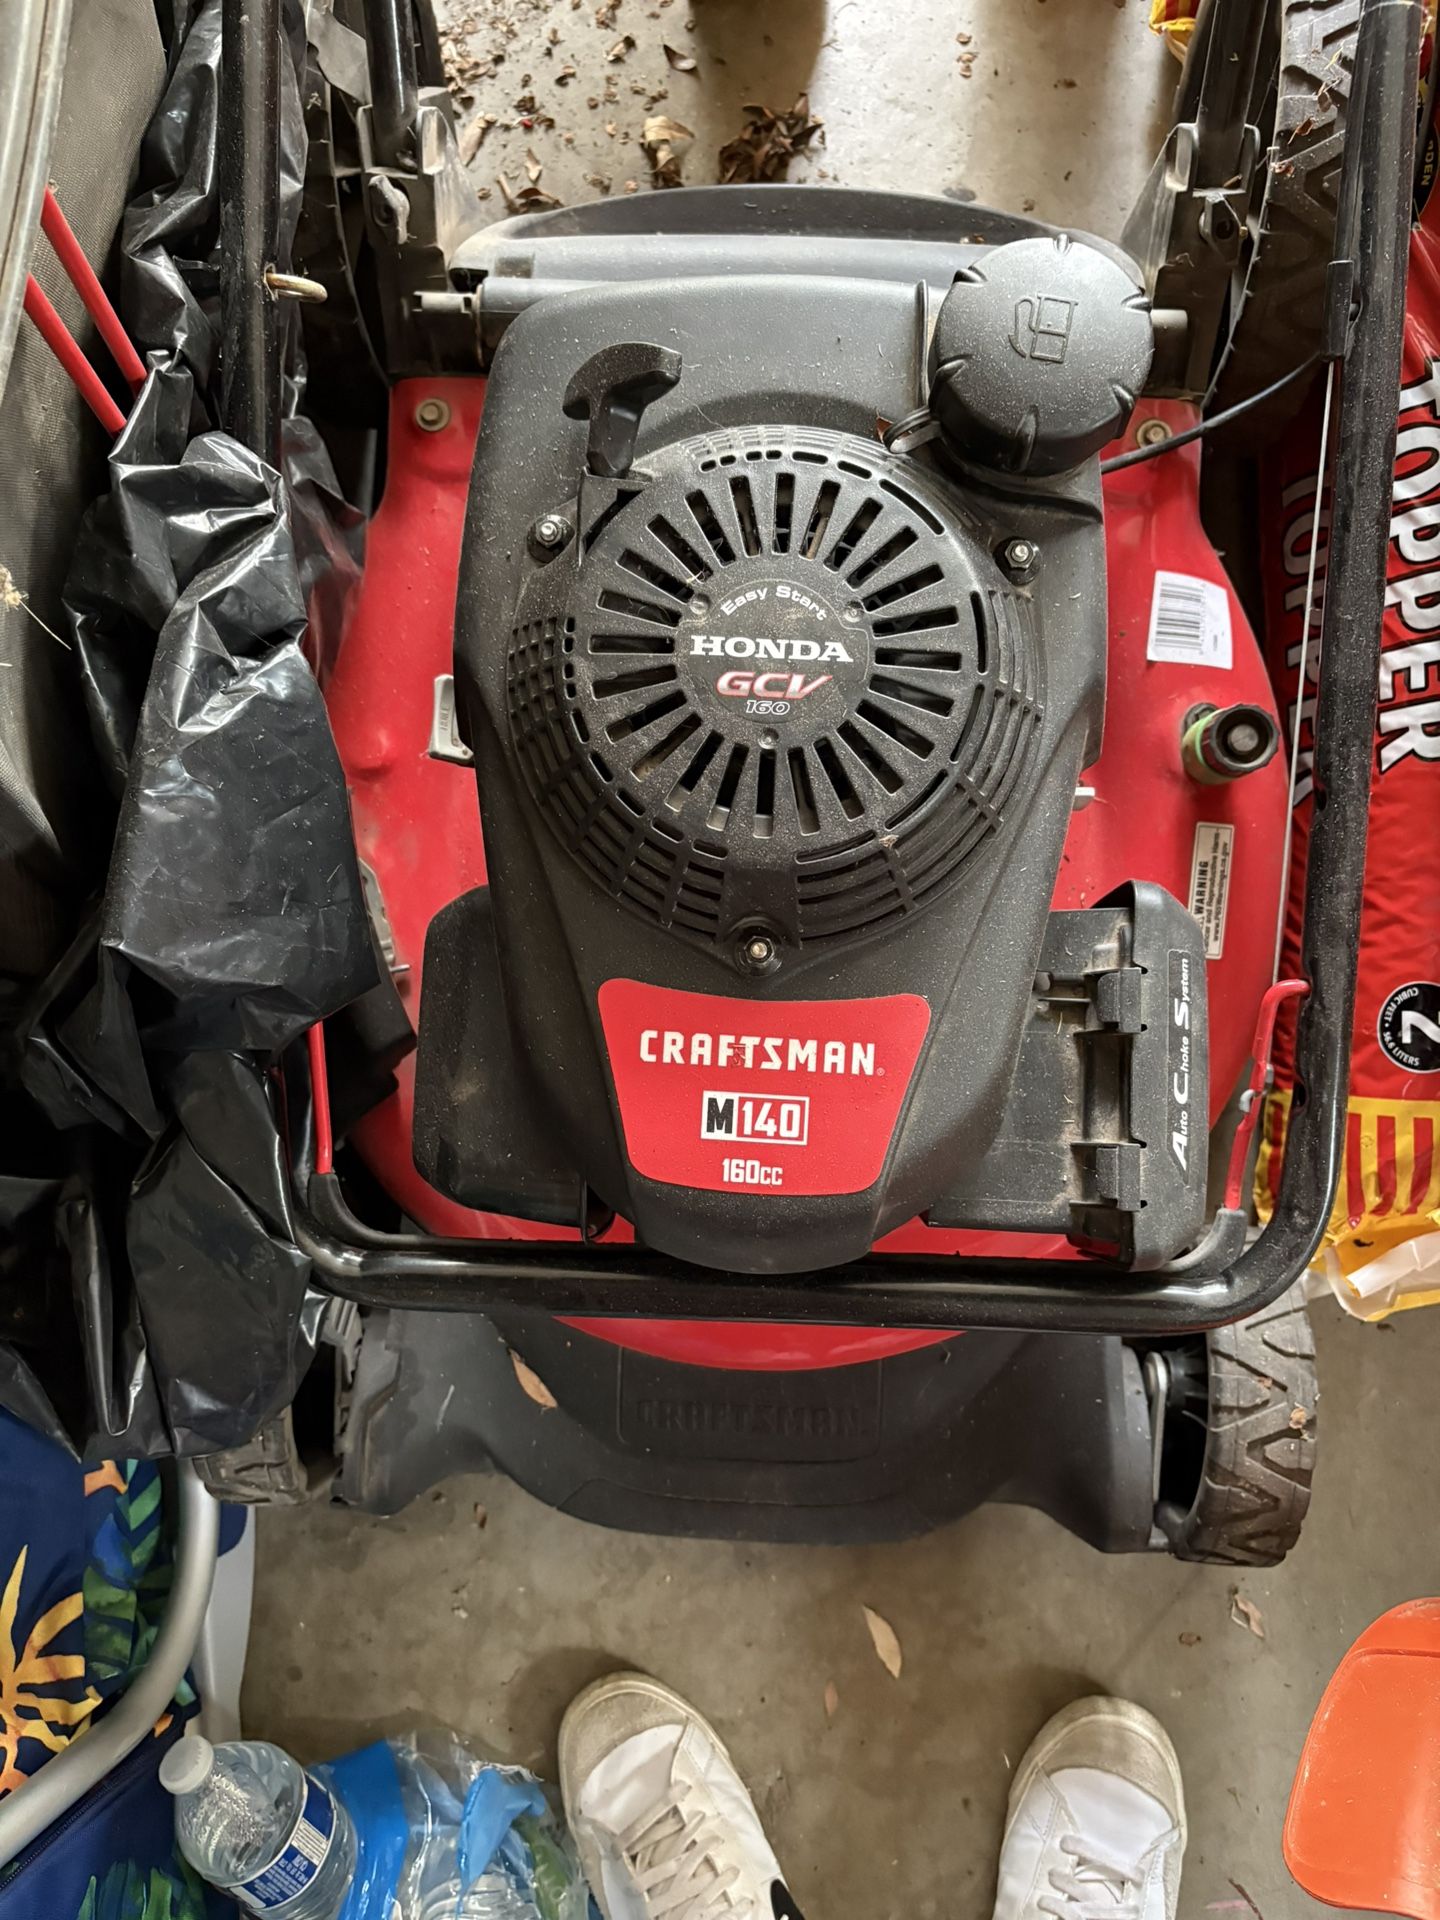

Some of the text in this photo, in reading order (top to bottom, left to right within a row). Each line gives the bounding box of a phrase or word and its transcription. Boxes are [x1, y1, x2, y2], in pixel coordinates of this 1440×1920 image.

[1379, 358, 1440, 773] TOPPER
[720, 584, 828, 621] Easy Start
[689, 634, 854, 663] HONDA
[716, 671, 834, 699] GCV
[746, 699, 791, 716] 160
[1194, 861, 1209, 915] WARNING
[1207, 856, 1217, 906] Reproductive
[1383, 987, 1420, 1067] CUBIC FEET 56.6 LITERS
[639, 1029, 876, 1076] CRAFTSMAN
[1172, 958, 1190, 1171] Auto Choke System
[705, 1096, 801, 1139] M140
[722, 1158, 783, 1186] 160cc
